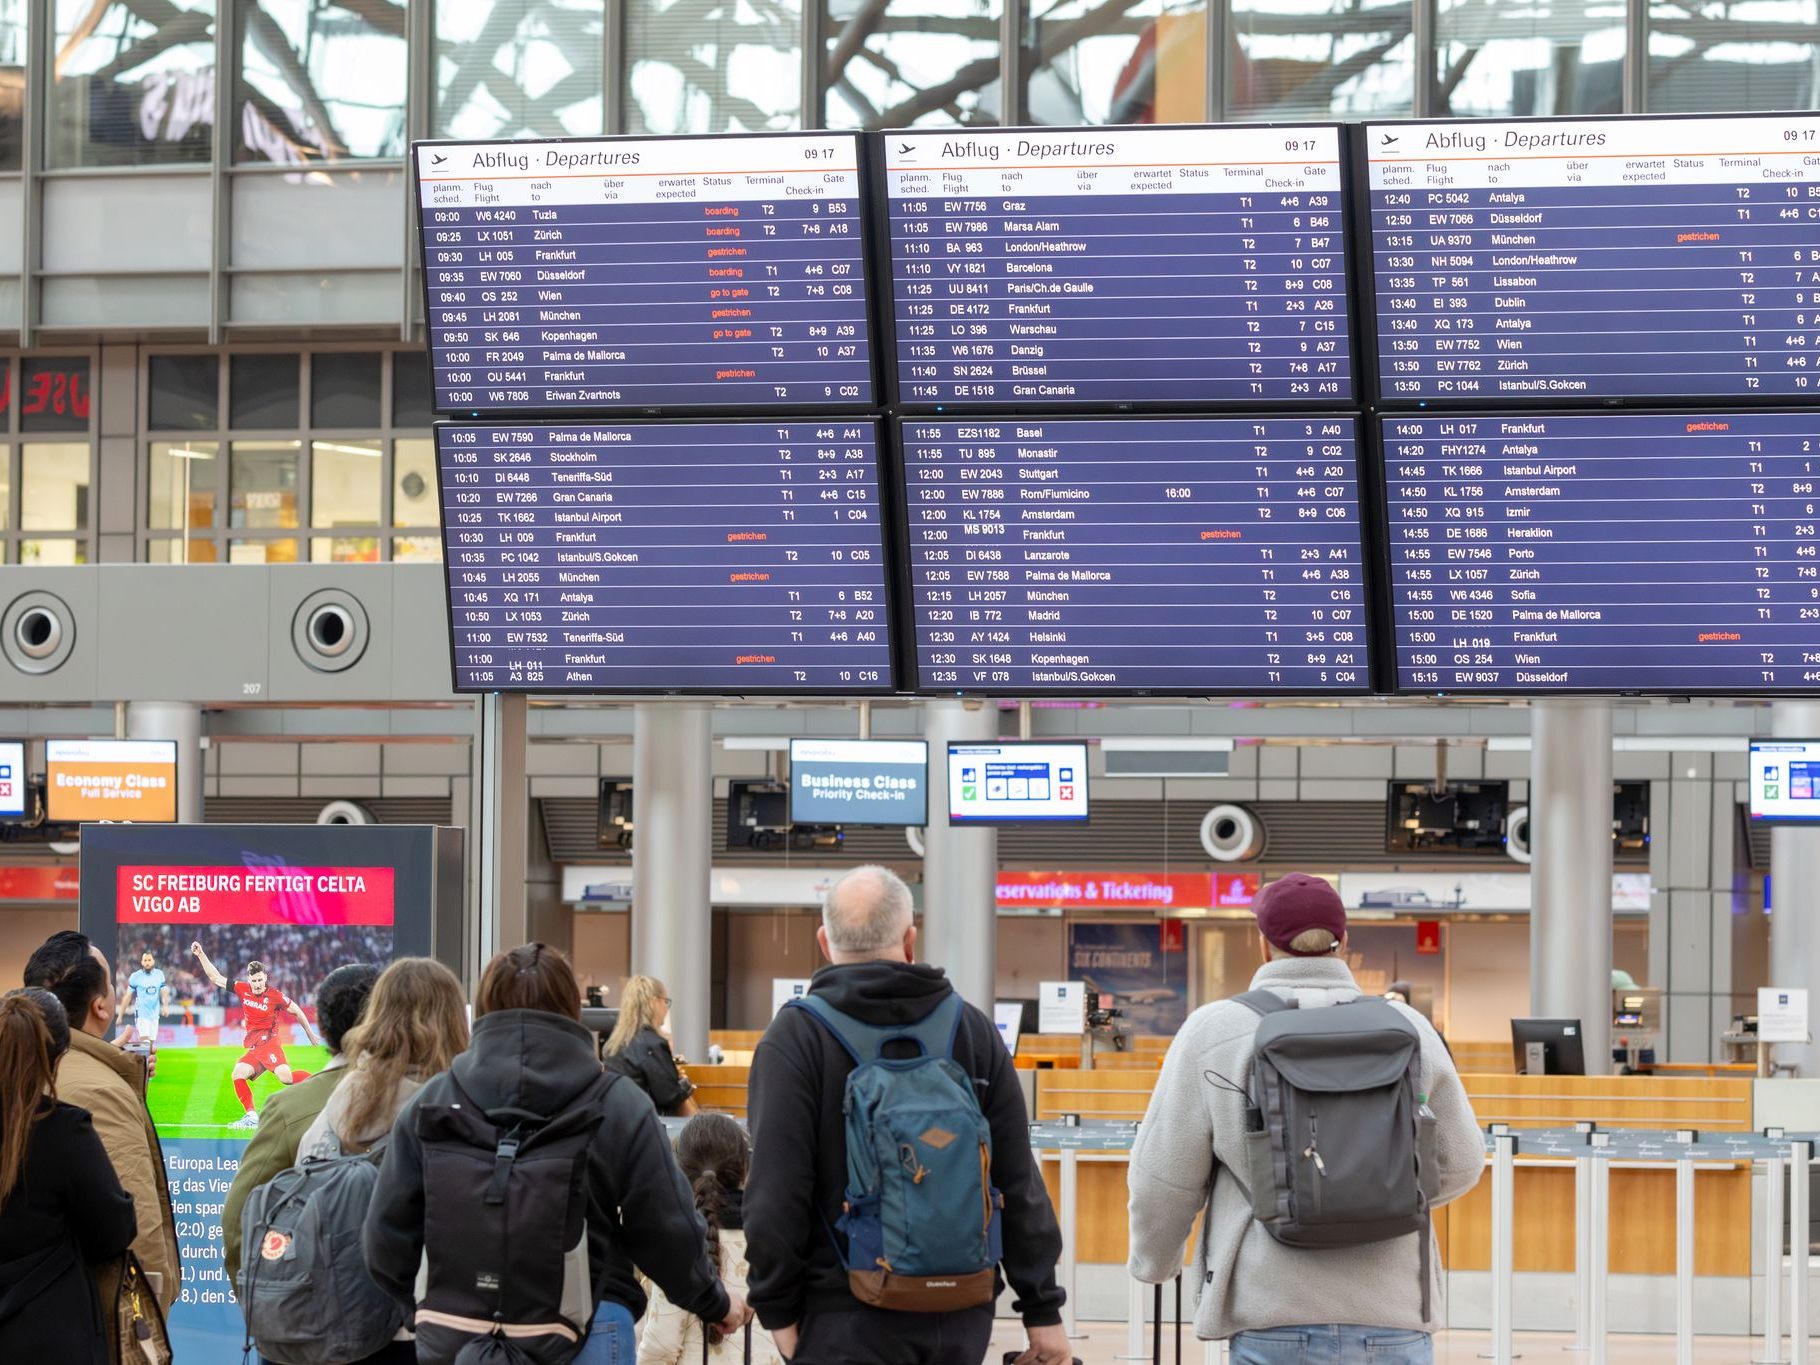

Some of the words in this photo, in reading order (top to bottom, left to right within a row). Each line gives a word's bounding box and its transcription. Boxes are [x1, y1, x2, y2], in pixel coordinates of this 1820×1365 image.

[1425, 132, 1486, 152] Abflug
[1504, 131, 1606, 150] Departures
[1783, 130, 1798, 141] 09
[1802, 130, 1816, 140] 17
[941, 141, 999, 161] Abflug
[1017, 140, 1115, 160] Departures
[1285, 140, 1299, 151] 09
[1303, 140, 1316, 151] 17
[472, 152, 528, 171] Abflug
[546, 151, 640, 170] Departures
[804, 149, 818, 159] 09
[822, 148, 834, 159] 17
[433, 184, 464, 194] planm.
[473, 183, 493, 192] Flug
[531, 181, 552, 190] nach
[604, 179, 624, 188] über
[658, 178, 696, 187] erwartet
[703, 177, 732, 186] Status
[746, 175, 784, 184] Terminal
[823, 174, 845, 183] Gate
[434, 194, 462, 203] sched.
[475, 194, 500, 204] Flight
[656, 189, 696, 199] expected
[785, 186, 824, 195] Check-in
[434, 211, 460, 222] 09:00
[475, 211, 492, 221] W6
[493, 210, 516, 221] 4240
[532, 209, 558, 220] Tuzla
[704, 206, 740, 217] boarding
[761, 204, 775, 215] T2
[812, 203, 819, 214] 9
[828, 202, 847, 214] B53
[903, 222, 929, 233] 11:05
[945, 222, 963, 233] EW
[964, 221, 988, 232] 7986
[1004, 221, 1034, 232] Marsa
[1034, 221, 1060, 231] Alam
[1241, 217, 1253, 228] T1
[1293, 217, 1301, 228] 6
[1310, 216, 1329, 228] B46
[904, 243, 930, 254] 11:10
[946, 242, 961, 253] BA
[965, 242, 983, 253] 963
[1005, 241, 1087, 253] London/Heathrow
[1242, 238, 1256, 249] T2
[1294, 237, 1302, 248] 7
[1311, 237, 1330, 248] B47
[1386, 235, 1413, 246] 13:15
[1430, 235, 1446, 246] UA
[1447, 234, 1472, 246] 9370
[1491, 234, 1536, 245] München
[1676, 231, 1720, 243] gestrichen
[440, 292, 466, 303] 09:40
[481, 291, 497, 302] OS
[500, 291, 518, 302] 252
[537, 290, 562, 301] Wien
[710, 289, 721, 299] go
[721, 288, 731, 297] to
[731, 288, 749, 298] gate
[767, 286, 780, 297] T2
[806, 285, 825, 296] 7+8
[832, 284, 852, 295] C08
[445, 352, 470, 363] 10:00
[486, 351, 500, 362] FR
[501, 351, 524, 362] 2049
[542, 351, 572, 361] Palma
[573, 350, 586, 361] de
[587, 350, 626, 361] Mallorca
[771, 347, 784, 358] T2
[817, 346, 829, 357] 10
[837, 345, 856, 356] A37
[1396, 424, 1423, 435] 14:00
[1440, 424, 1454, 435] LH
[1459, 424, 1477, 434] 017
[1501, 423, 1545, 434] Frankfurt
[1686, 422, 1729, 433] gestrichen
[920, 489, 945, 500] 12:00
[961, 489, 980, 500] EW
[980, 489, 1005, 499] 7886
[1020, 488, 1090, 499] Rom/Fiumicino
[1165, 487, 1191, 498] 16:00
[1256, 487, 1269, 498] T1
[1297, 487, 1316, 497] 4+6
[1324, 487, 1344, 497] C07
[1400, 487, 1427, 497] 14:50
[1444, 486, 1458, 497] KL
[1460, 486, 1484, 497] 1756
[1504, 485, 1561, 496] Amsterdam
[1750, 483, 1765, 494] T2
[1793, 483, 1813, 494] 8+9
[457, 512, 482, 523] 10:25
[497, 512, 512, 523] TK
[513, 512, 535, 523] 1662
[554, 512, 590, 522] Istanbul
[591, 512, 622, 524] Airport
[782, 510, 795, 521] T1
[833, 510, 839, 520] 1
[848, 509, 868, 520] C04
[460, 552, 485, 563] 10:35
[500, 552, 515, 563] PC
[517, 552, 540, 563] 1042
[557, 552, 639, 562] Istanbul/S.Gokcen
[785, 550, 798, 561] T2
[831, 550, 843, 561] 10
[850, 550, 870, 561] C05
[929, 631, 955, 642] 12:30
[970, 631, 985, 642] AY
[987, 631, 1010, 642] 1424
[1029, 631, 1066, 642] Helsinki
[1265, 631, 1278, 642] T1
[1306, 631, 1325, 642] 3+5
[1333, 631, 1354, 642] C08
[243, 683, 261, 694] 207
[56, 773, 122, 788] Economy
[125, 774, 166, 788] Class
[801, 774, 870, 788] Business
[874, 775, 916, 789] Class
[81, 788, 100, 798] Full
[103, 788, 142, 798] Service
[813, 789, 853, 801] Priority
[856, 789, 905, 800] Check-in
[133, 874, 153, 890] SC
[158, 875, 240, 891] FREIBURG
[246, 876, 313, 892] FERTIGT
[318, 876, 365, 892] CELTA
[996, 881, 1082, 900] eservations
[1085, 882, 1098, 899] &
[1103, 881, 1173, 903] Ticketing
[133, 896, 174, 912] VIGO
[178, 896, 200, 912] AB
[170, 1156, 213, 1172] Europa
[217, 1156, 241, 1170] Lea
[183, 1178, 205, 1192] das
[175, 1222, 204, 1238] (2:0)
[182, 1244, 217, 1258] durch
[199, 1267, 222, 1281] und
[201, 1289, 225, 1303] den
